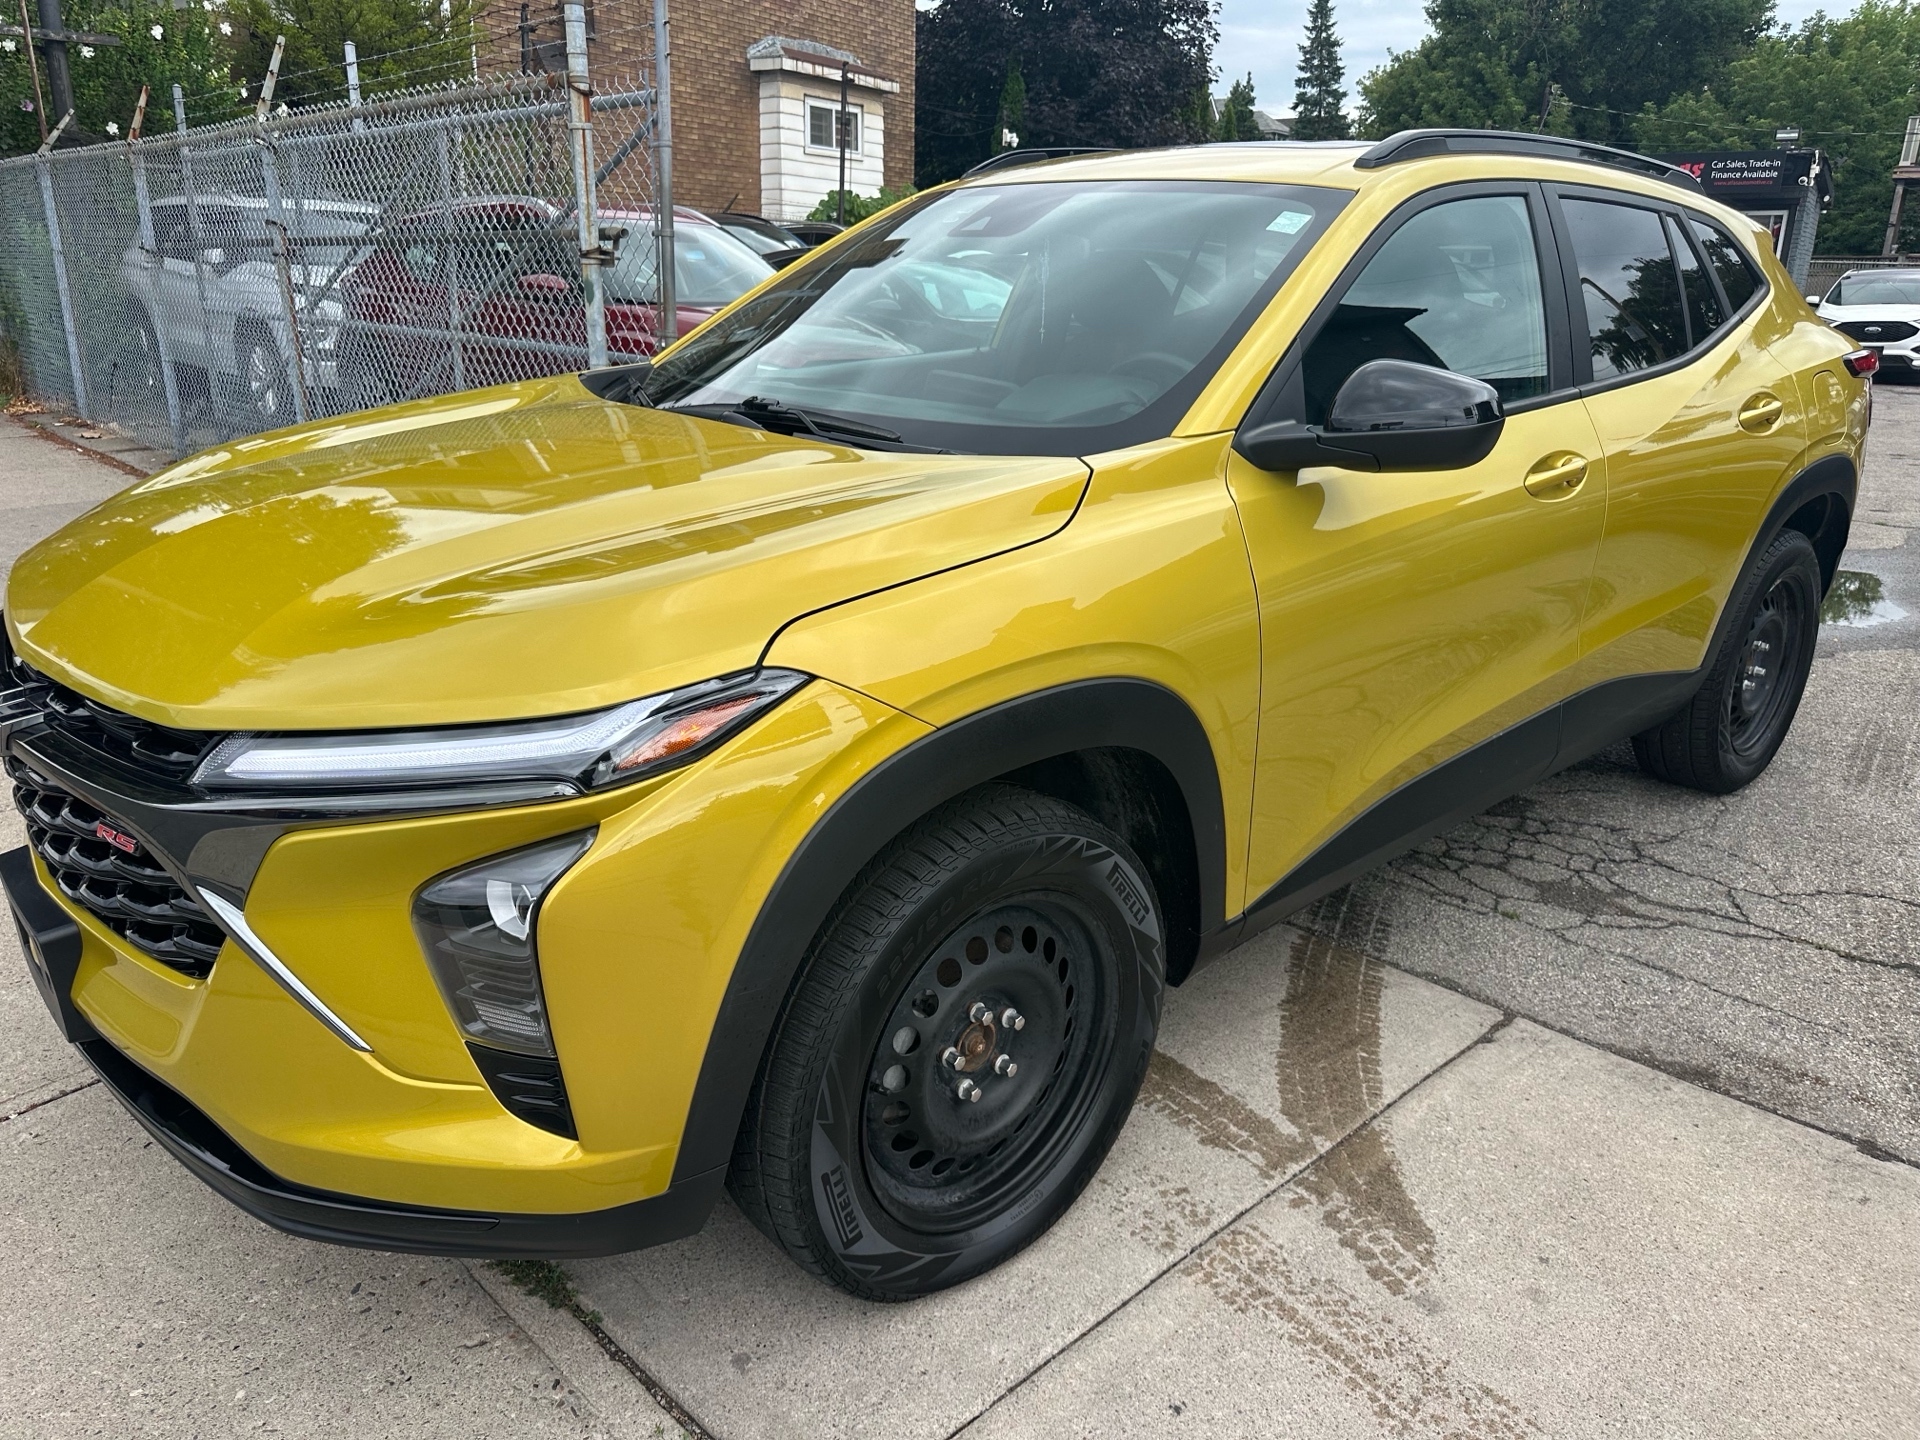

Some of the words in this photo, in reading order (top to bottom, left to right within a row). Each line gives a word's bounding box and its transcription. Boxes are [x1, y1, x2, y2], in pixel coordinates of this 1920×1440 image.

[1711, 160, 1724, 169] Car
[1726, 160, 1747, 169] Sales,
[1749, 159, 1781, 168] Trade-in
[1711, 170, 1741, 179] Finance
[1742, 169, 1778, 178] Available
[97, 824, 136, 853] RS
[1105, 861, 1150, 926] PIRELLI
[821, 1164, 864, 1251] PIRELLI
